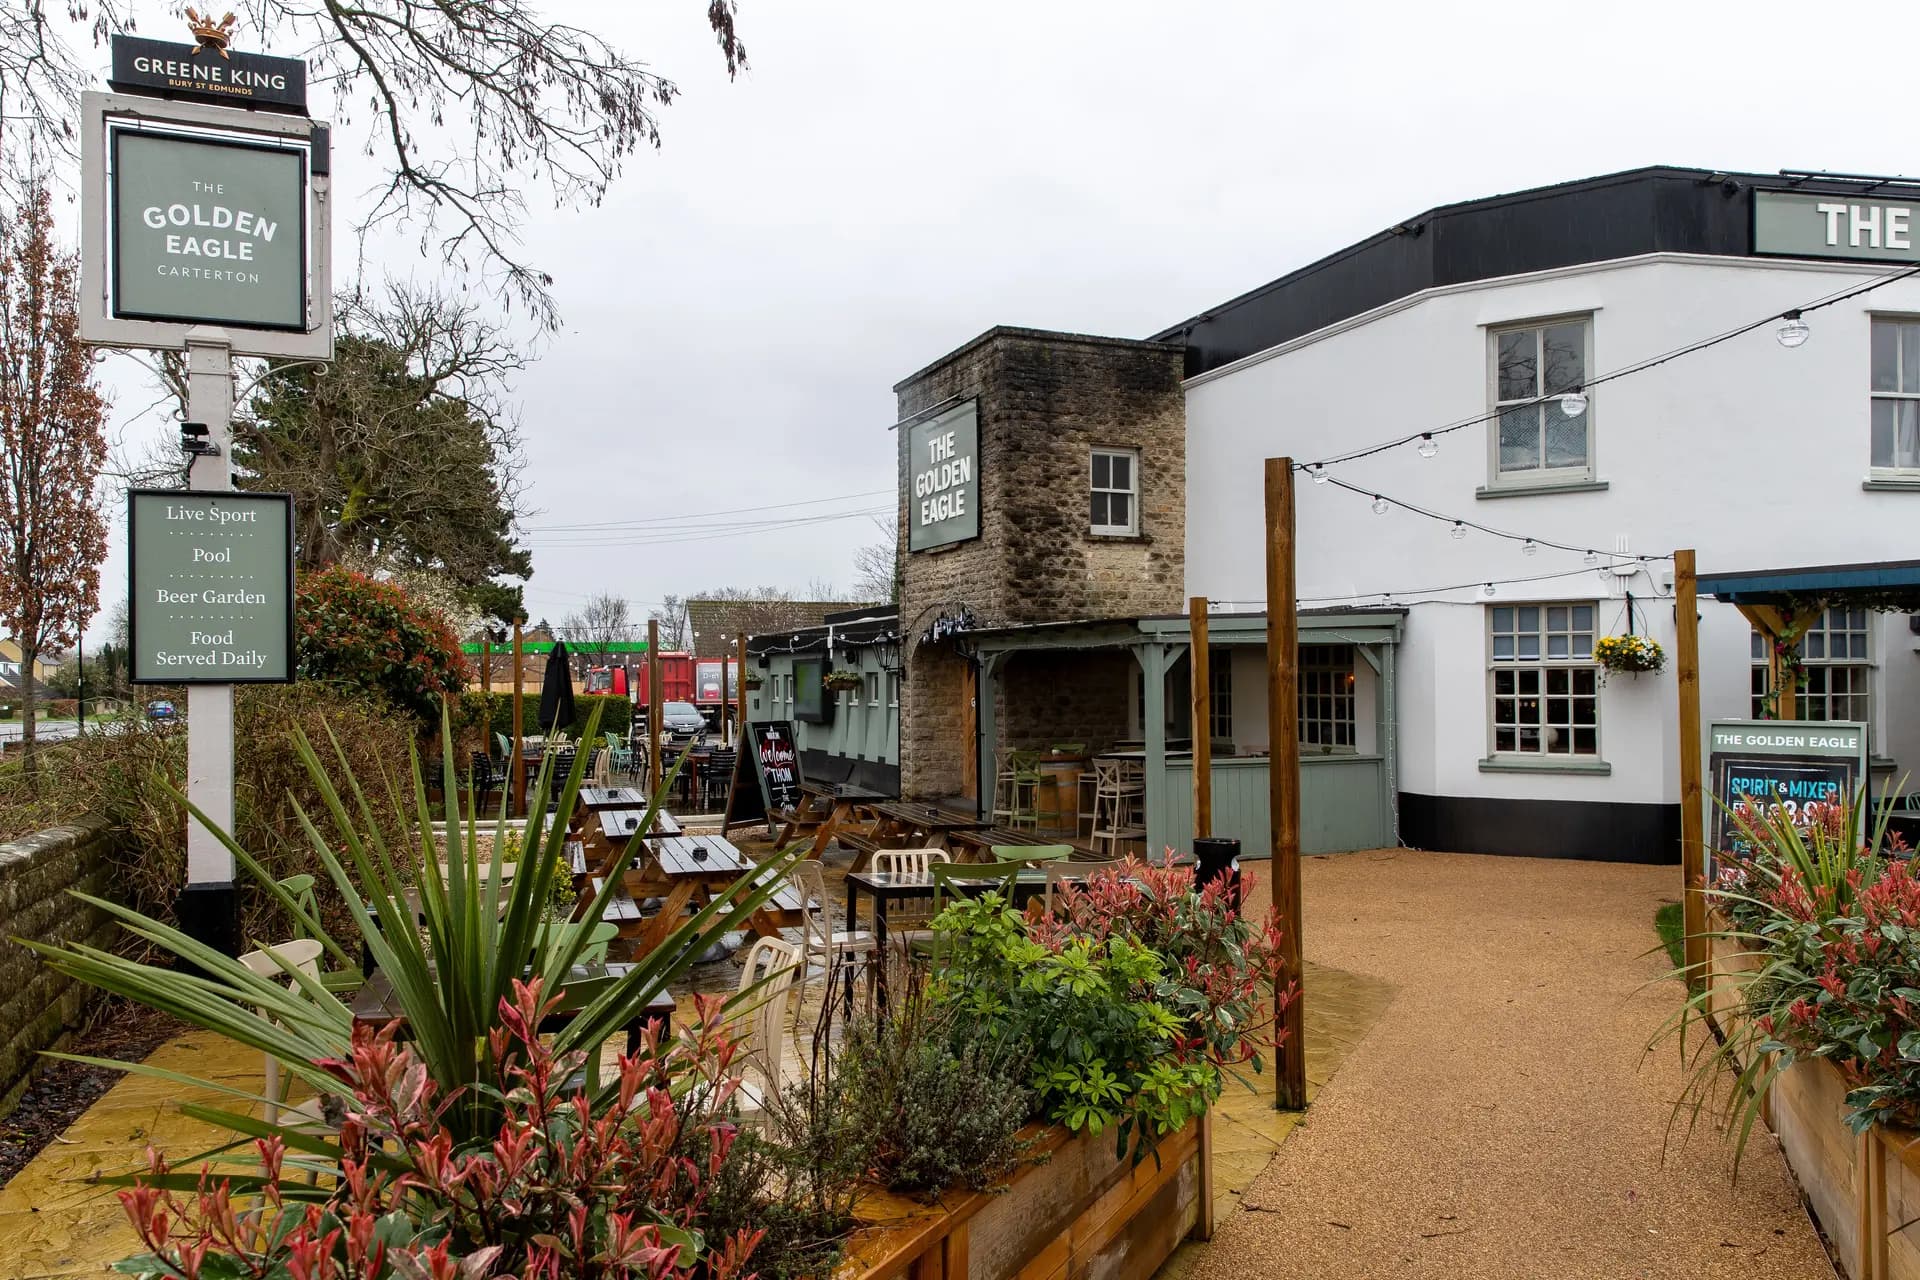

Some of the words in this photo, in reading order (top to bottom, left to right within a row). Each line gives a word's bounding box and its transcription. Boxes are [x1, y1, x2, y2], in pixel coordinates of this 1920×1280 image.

[134, 57, 222, 82] GREENE
[231, 69, 286, 90] KING
[168, 78, 193, 88] BURY
[208, 83, 253, 96] EDMUNDS
[192, 181, 224, 195] THE
[143, 203, 278, 242] GOLDEN
[1817, 203, 1911, 250] THE
[166, 235, 254, 261] EAGLE
[157, 264, 260, 284] CARTERTON
[928, 431, 956, 465] THE
[915, 456, 971, 499] GOLDEN
[166, 505, 205, 521] Live
[209, 507, 257, 525] Sport
[921, 489, 965, 526] EAGLE
[192, 548, 231, 563] Pool
[156, 589, 198, 604] Beer
[202, 589, 266, 605] Garden
[190, 630, 234, 646] Food
[156, 651, 216, 666] Served
[221, 651, 268, 669] Daily
[1715, 734, 1742, 745] THE
[1746, 735, 1805, 747] GOLDEN
[1809, 737, 1857, 749] EAGLE
[1731, 777, 1778, 796] SPIRIT
[1778, 782, 1788, 793] &
